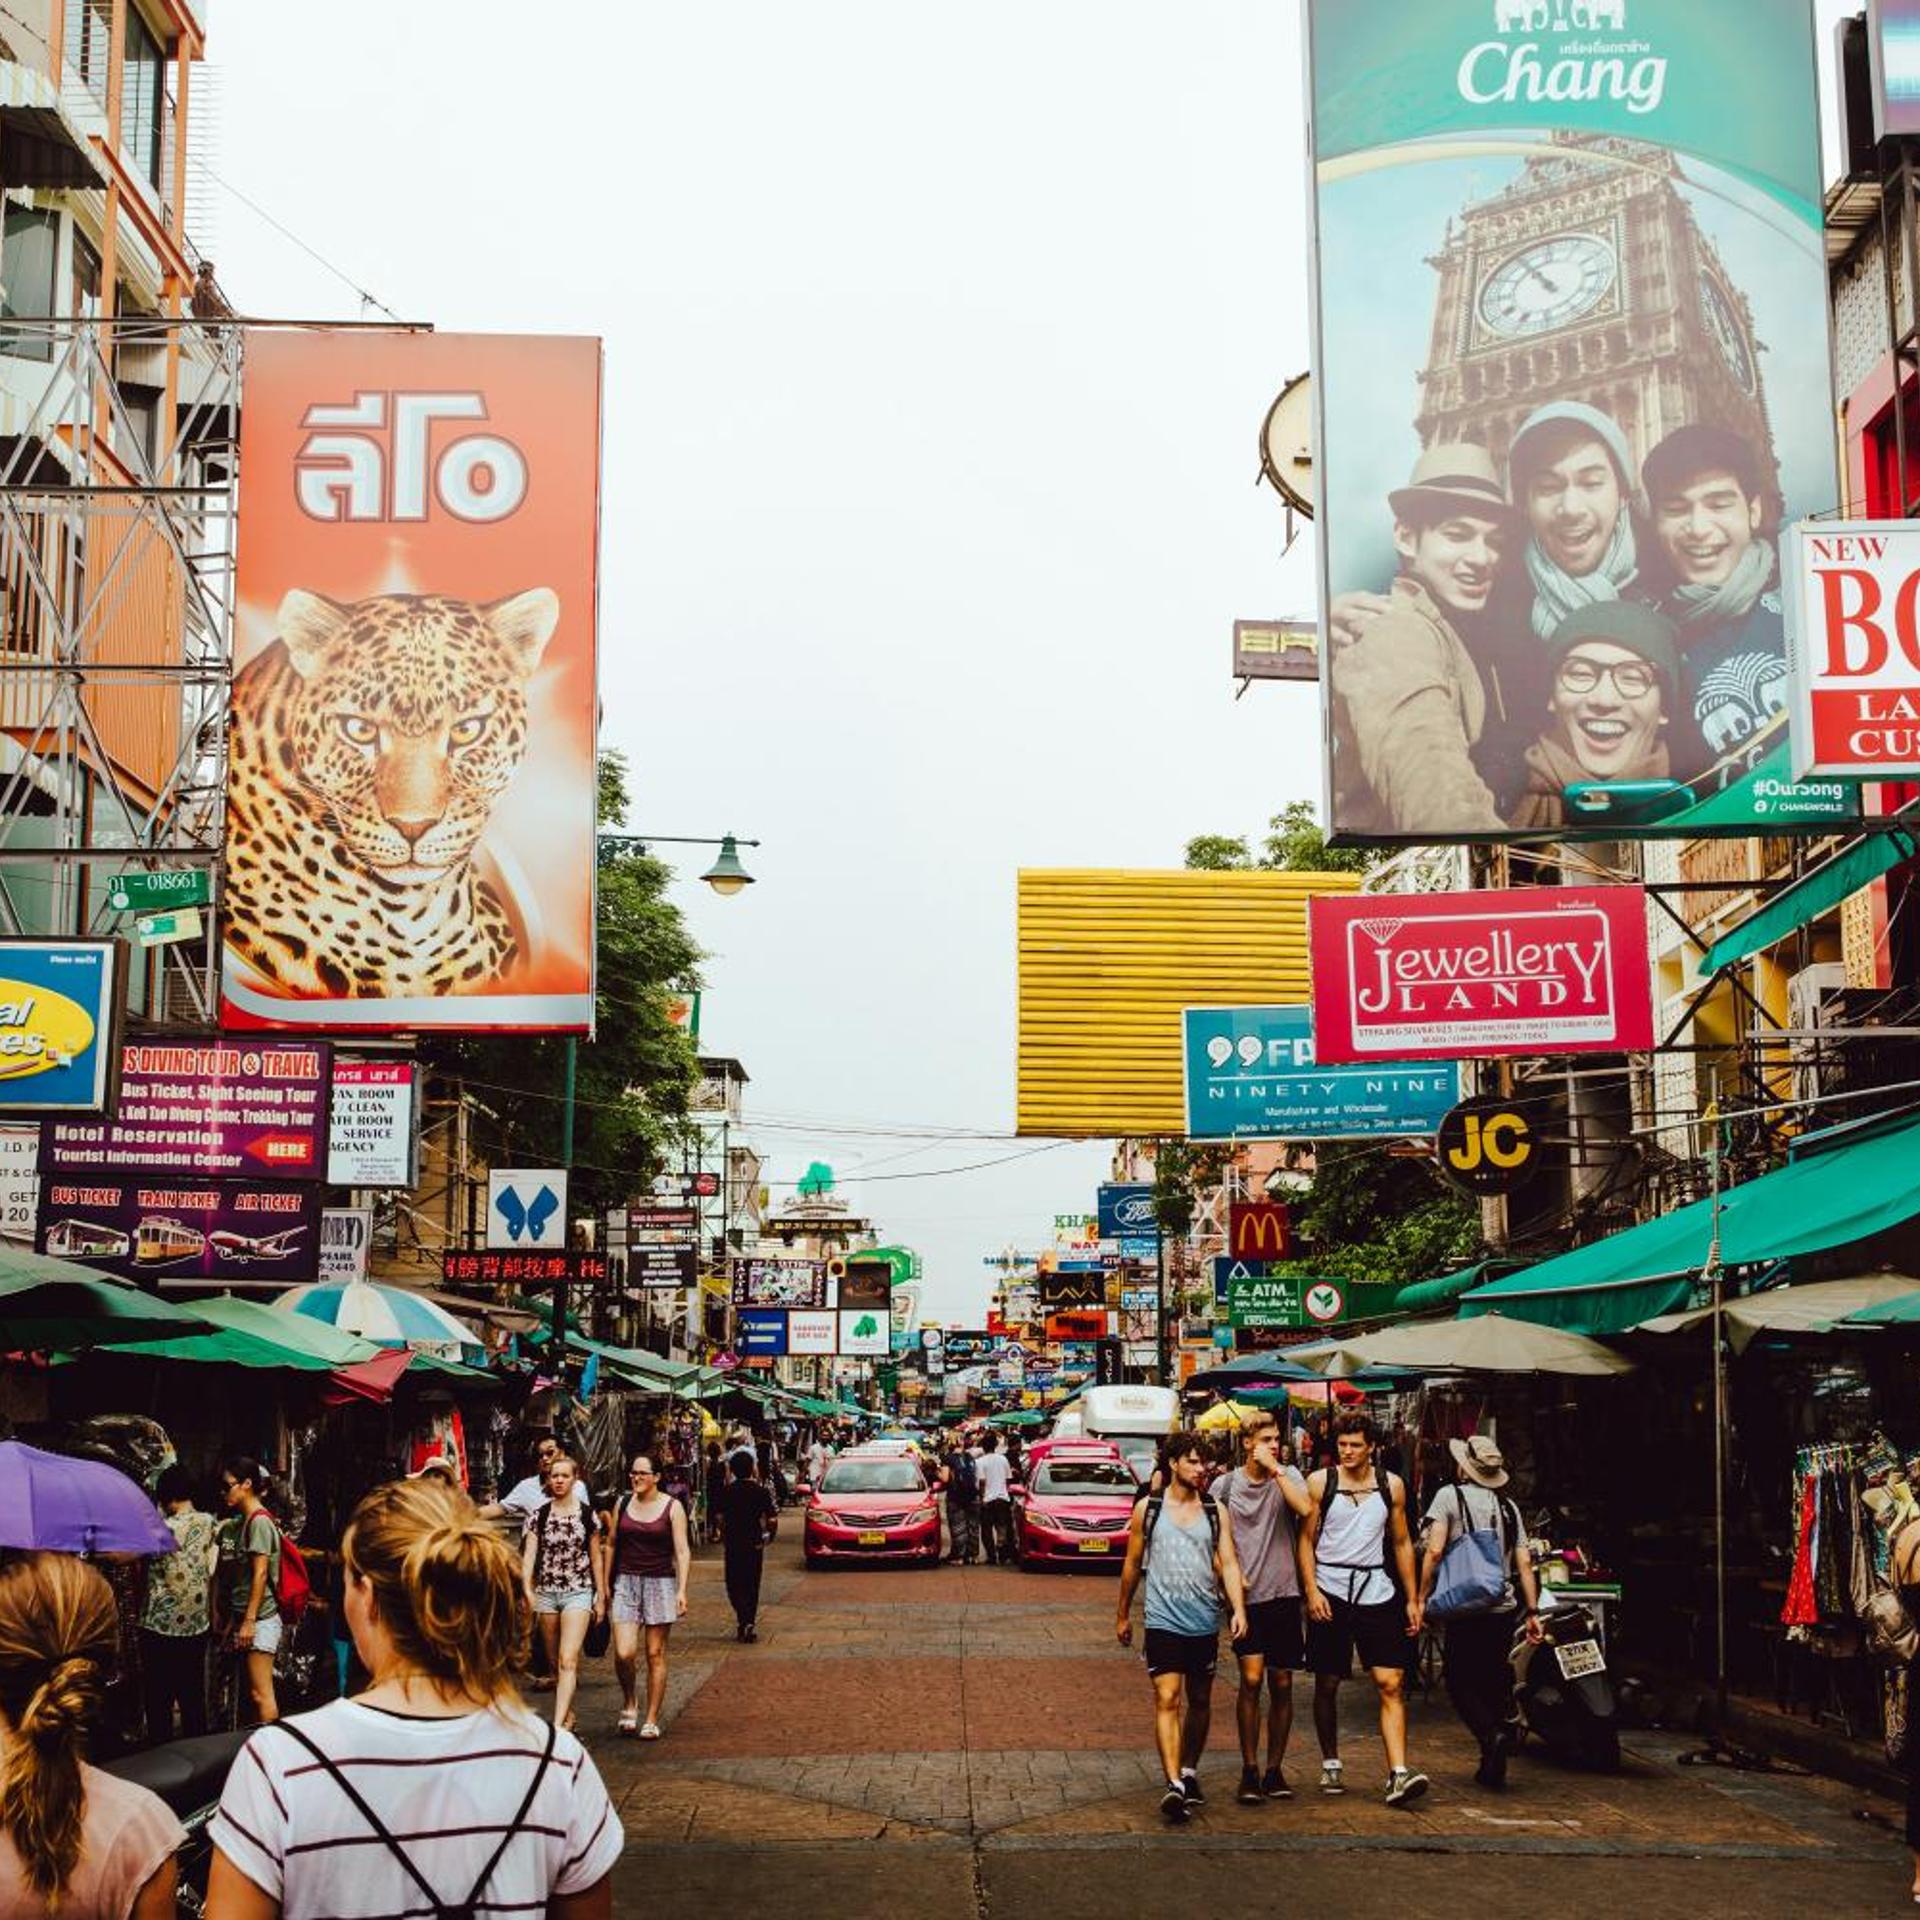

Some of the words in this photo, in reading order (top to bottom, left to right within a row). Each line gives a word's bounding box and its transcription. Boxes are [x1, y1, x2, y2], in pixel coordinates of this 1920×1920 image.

[1457, 41, 1668, 113] Chang
[1812, 537, 1888, 561] NEW
[1849, 729, 1920, 757] CU
[1752, 779, 1843, 800] #OurSong
[108, 877, 125, 893] 01
[147, 873, 197, 891] 018661
[1401, 980, 1568, 1012] LAND
[140, 1047, 196, 1075] DIVING
[197, 1050, 240, 1077] TOUR
[242, 1053, 261, 1075] &
[263, 1052, 319, 1079] TRAVEL
[121, 1082, 149, 1098] Bus
[237, 1086, 283, 1104] Seeing
[286, 1088, 317, 1104] Tour
[358, 1089, 395, 1100] ROOM
[1209, 1083, 1335, 1098] NINETY
[1366, 1078, 1448, 1093] NINE
[348, 1102, 386, 1113] CLEAN
[1324, 1104, 1339, 1114] and
[290, 1111, 315, 1127] Tour
[357, 1115, 393, 1126] ROOM
[55, 1125, 104, 1142] Hotel
[111, 1127, 224, 1147] Reservation
[343, 1128, 394, 1140] SERVICE
[1449, 1113, 1531, 1171] JC
[53, 1148, 104, 1163] Tourist
[107, 1150, 191, 1167] Information
[194, 1153, 242, 1169] Center
[266, 1141, 306, 1159] HERE
[9, 1191, 37, 1203] GET
[51, 1186, 78, 1205] BUS
[80, 1188, 121, 1207] TICKET
[138, 1189, 177, 1208] TRAIN
[178, 1191, 220, 1210] TICKET
[234, 1193, 258, 1210] AIR
[260, 1195, 302, 1212] TICKET
[8, 1207, 30, 1222] 20
[1253, 1283, 1287, 1297] ATM
